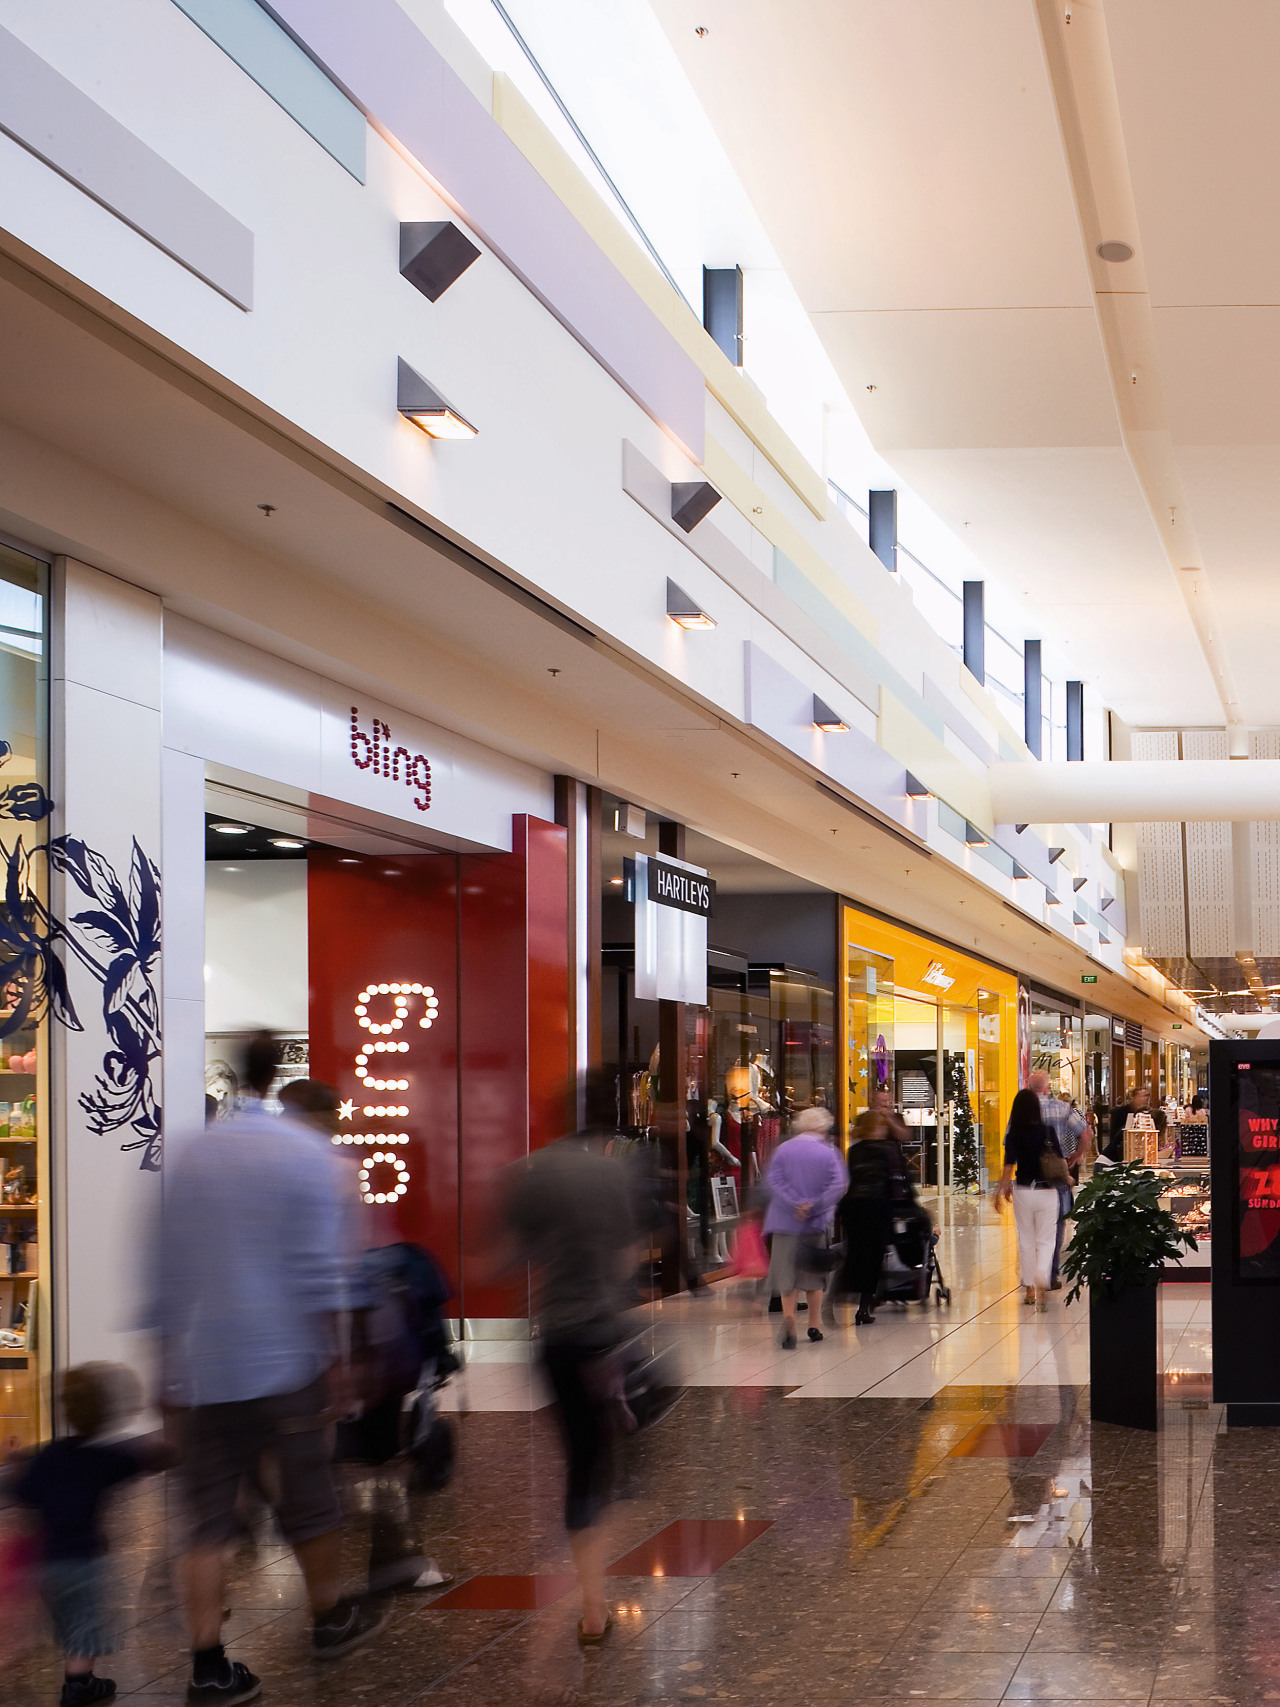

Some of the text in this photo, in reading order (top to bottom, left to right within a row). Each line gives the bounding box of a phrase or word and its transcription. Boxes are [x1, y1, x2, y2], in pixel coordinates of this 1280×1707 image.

[350, 706, 432, 811] bling
[657, 869, 710, 909] HARTLEYS
[1033, 1052, 1080, 1075] Max
[1248, 1118, 1279, 1132] WHY
